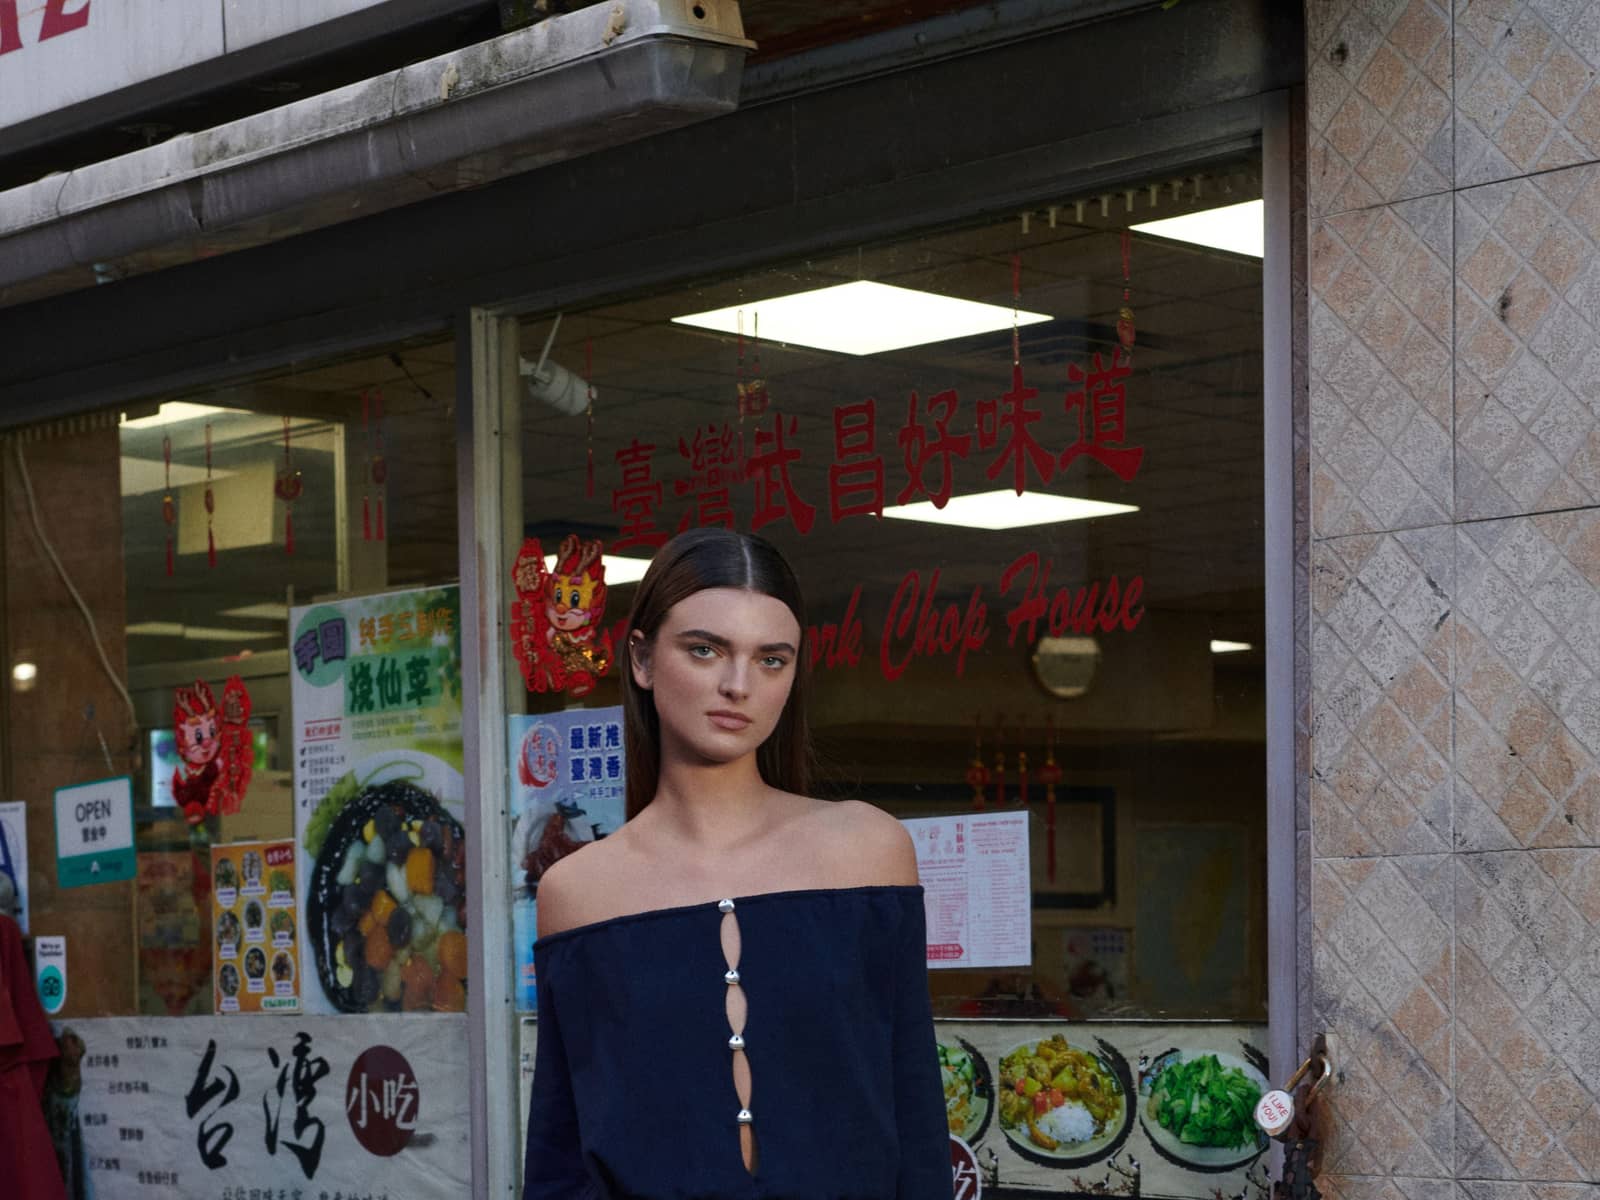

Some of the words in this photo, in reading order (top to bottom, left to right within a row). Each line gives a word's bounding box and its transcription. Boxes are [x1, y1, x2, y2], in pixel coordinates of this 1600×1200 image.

[611, 347, 1143, 553] 臺灣武昌好味道
[807, 583, 865, 670] ork
[880, 567, 990, 682] Chop
[1000, 551, 1145, 648] House
[75, 798, 111, 823] OPEN
[347, 1073, 418, 1130] 小吃
[1262, 1103, 1279, 1123] YOU!
[1271, 1098, 1289, 1117] LIKE
